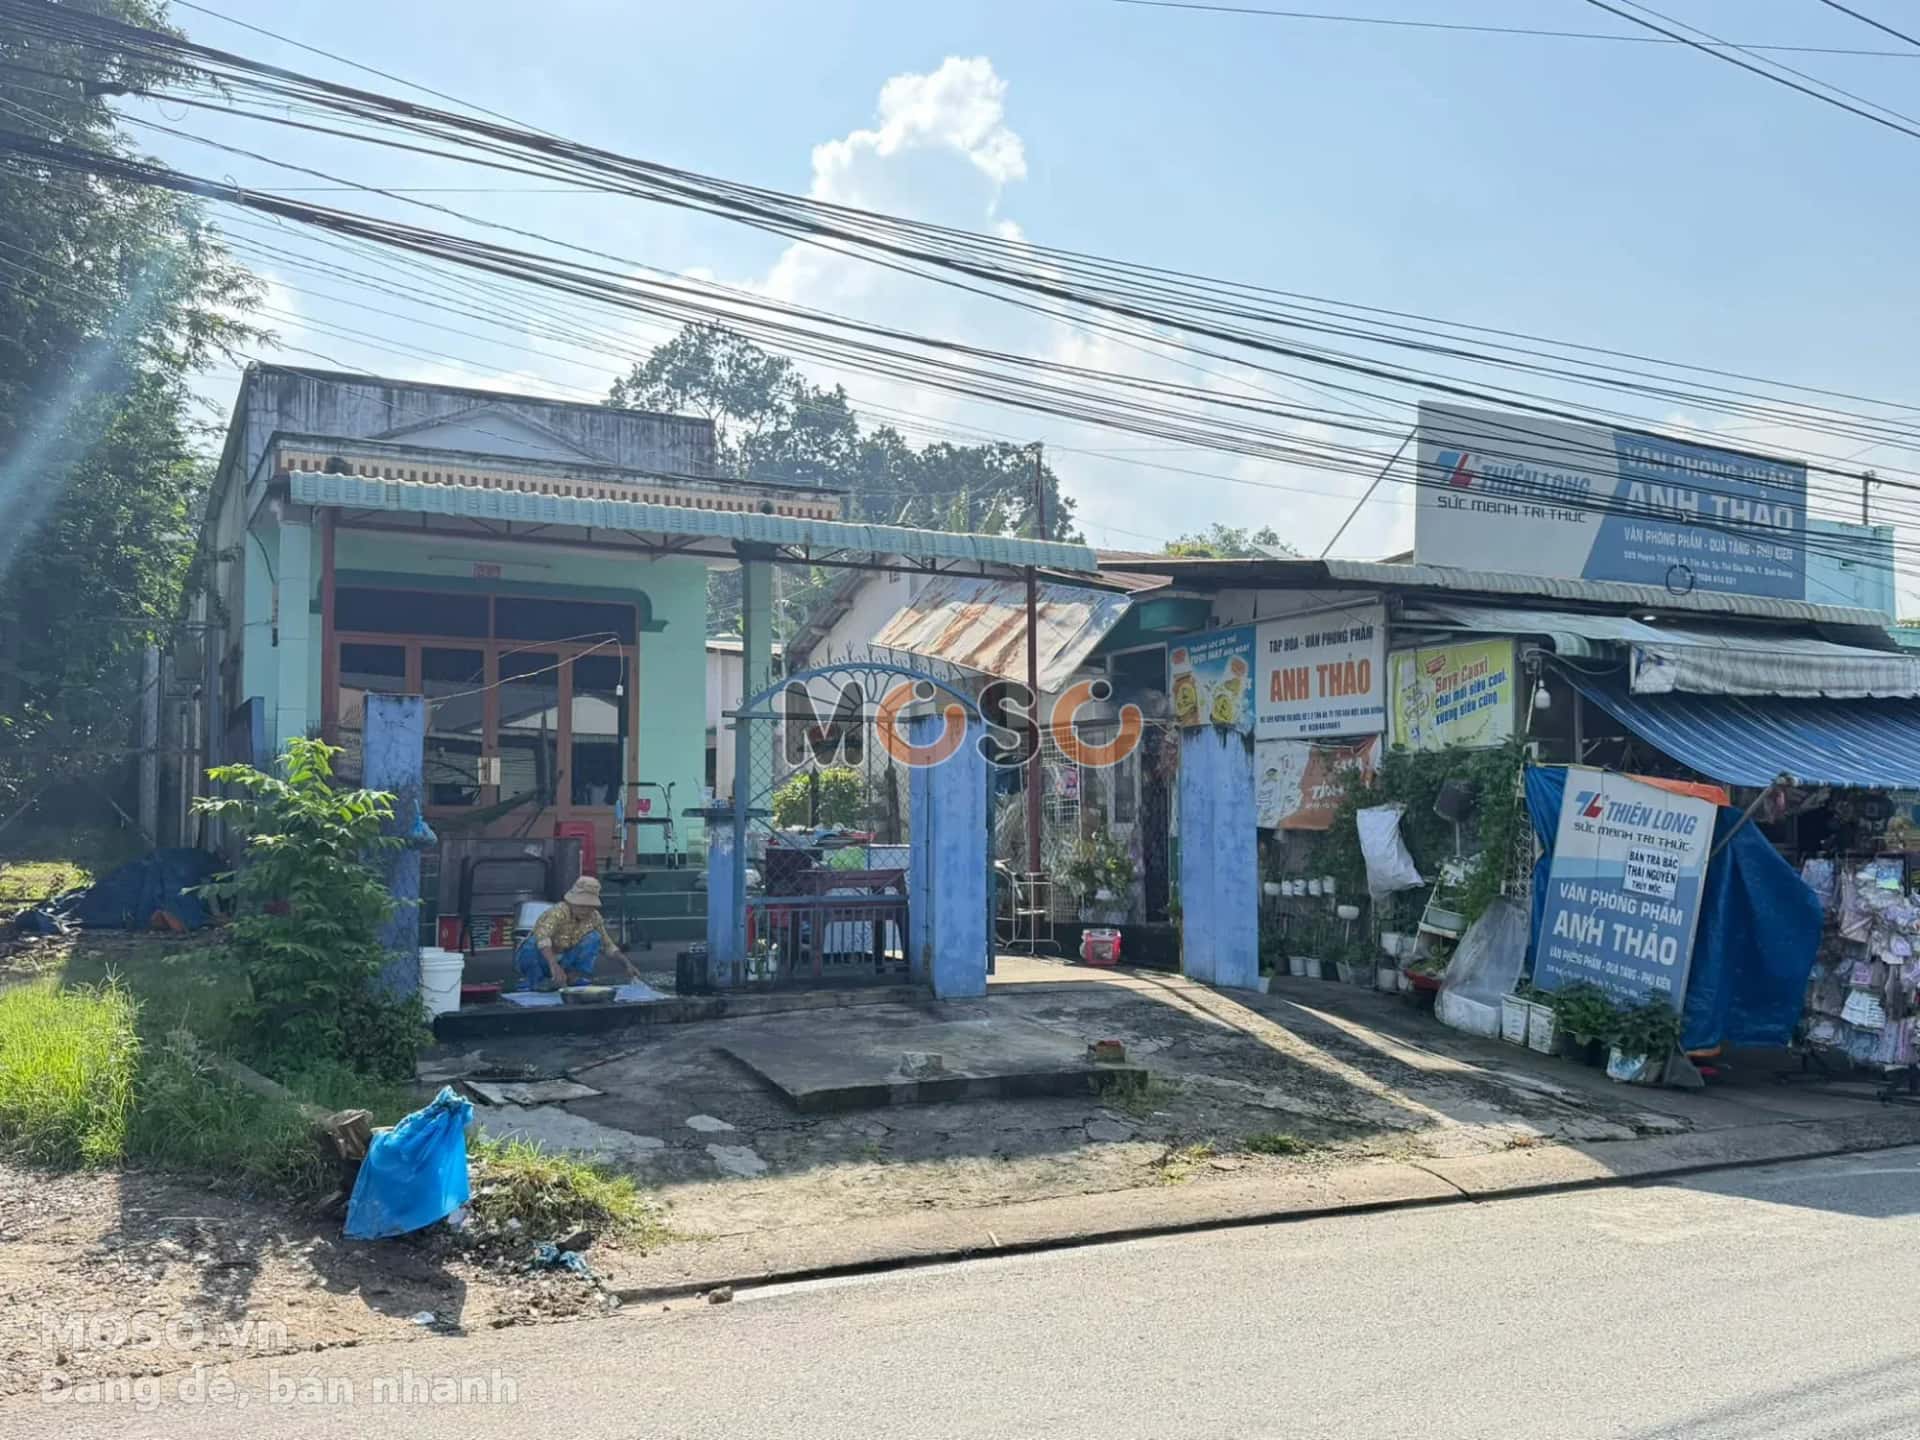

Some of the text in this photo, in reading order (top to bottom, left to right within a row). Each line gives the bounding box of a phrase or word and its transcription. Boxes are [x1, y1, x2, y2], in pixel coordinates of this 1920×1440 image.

[1627, 480, 1699, 520] ANH
[1270, 652, 1371, 703] ANH THẢO
[1606, 801, 1698, 835] THIÊN LONG
[1560, 881, 1684, 926] VĂN PHÒNG PHẨM
[1552, 909, 1678, 966] ANH THẢO
